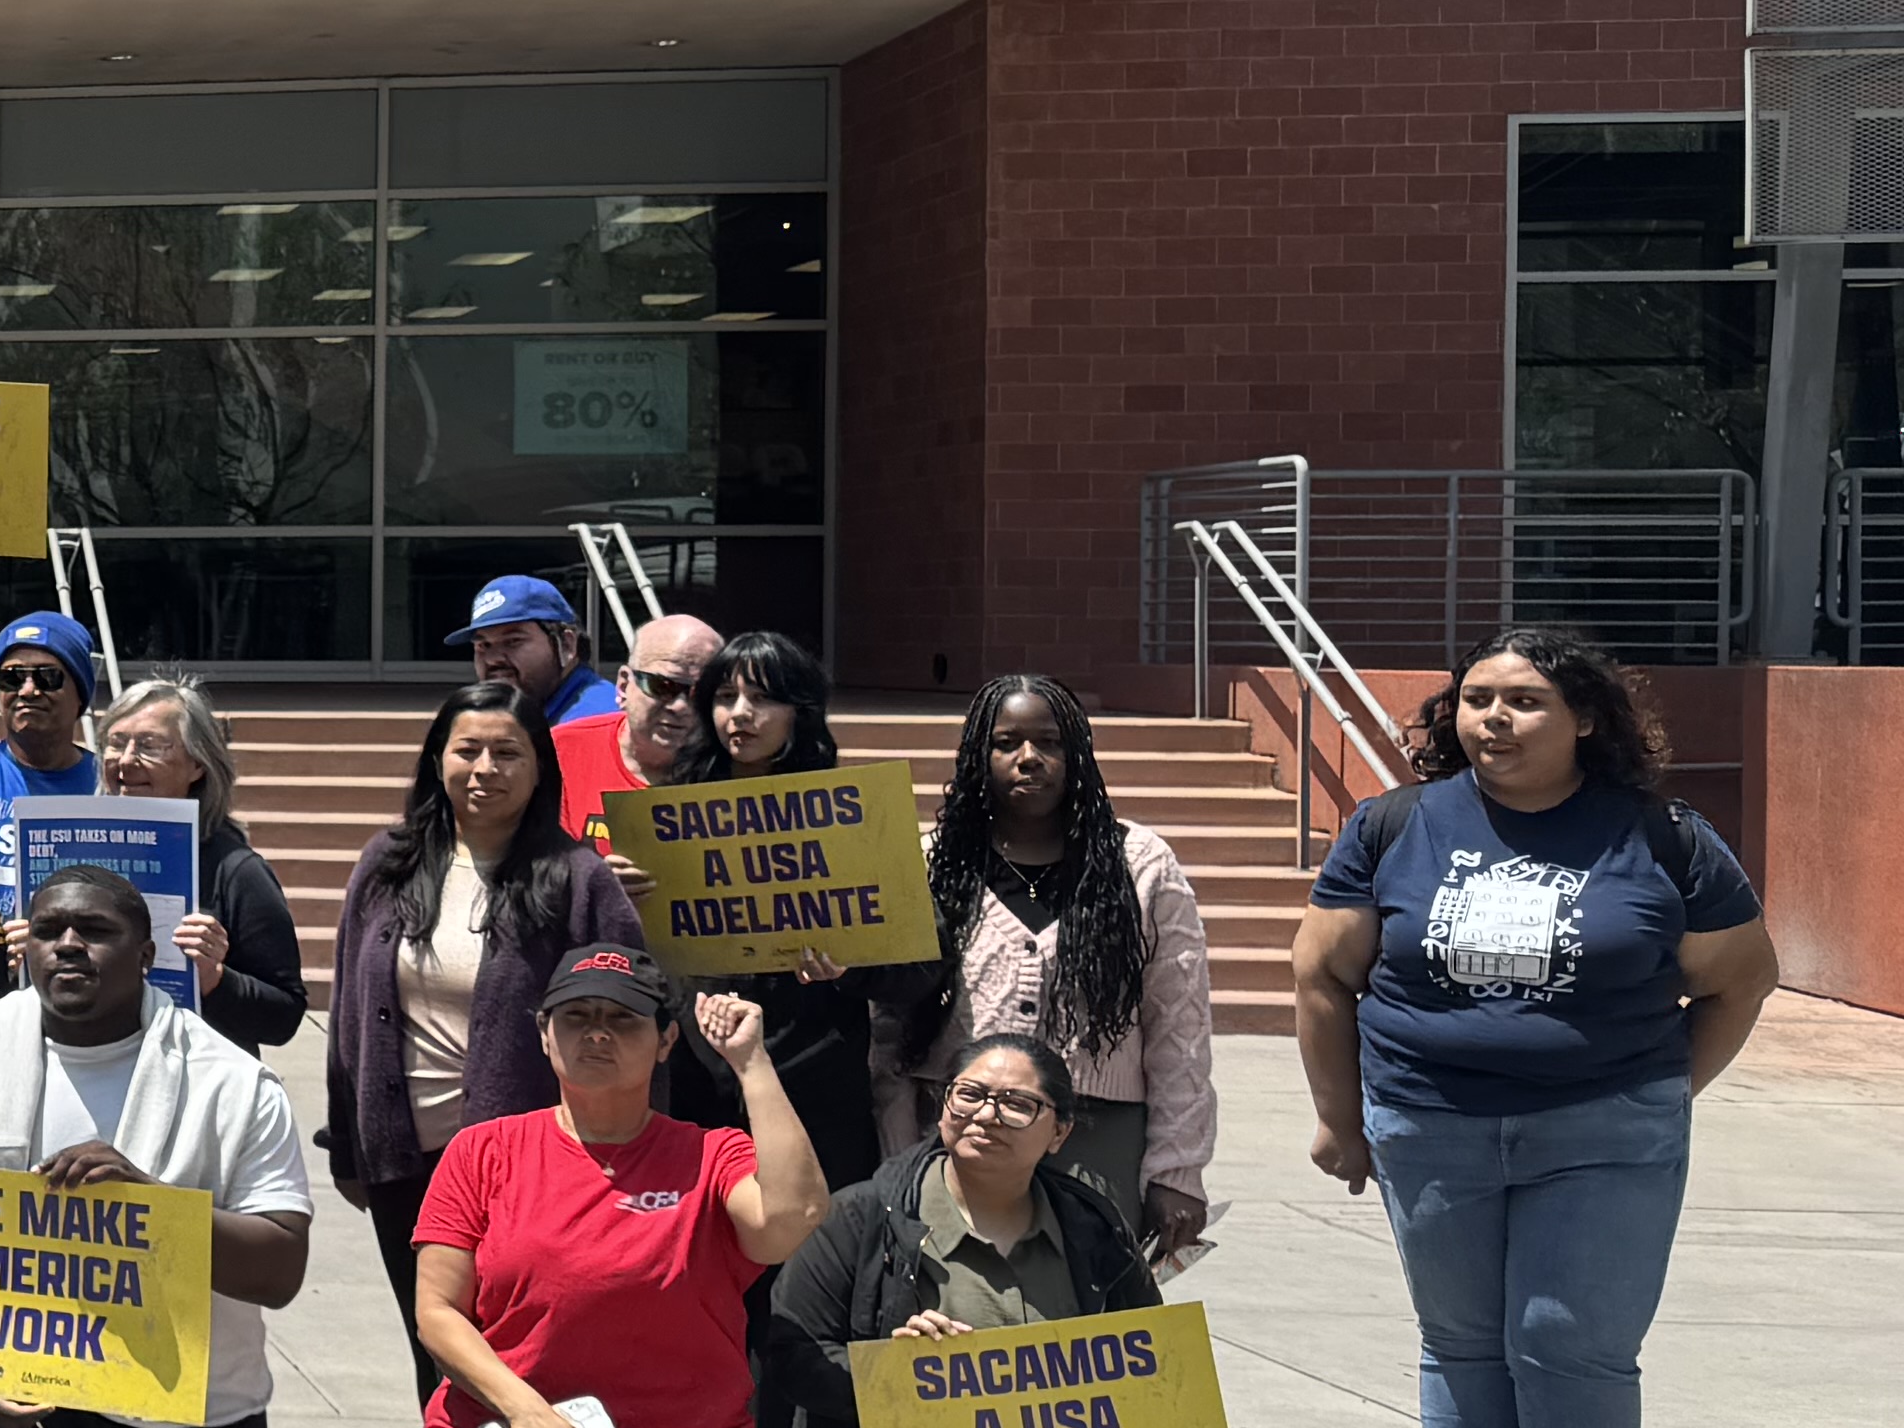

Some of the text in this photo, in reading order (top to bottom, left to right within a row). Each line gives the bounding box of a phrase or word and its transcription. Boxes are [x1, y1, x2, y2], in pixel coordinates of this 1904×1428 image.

[542, 390, 658, 429] 80%
[28, 829, 158, 845] THE CSU TAKES ON MORE
[651, 785, 863, 842] SACAMOS
[704, 839, 830, 888] A USA
[670, 884, 885, 938] ADELANTE
[18, 1192, 151, 1251] MAKE
[912, 1329, 1158, 1401] SACAMOS
